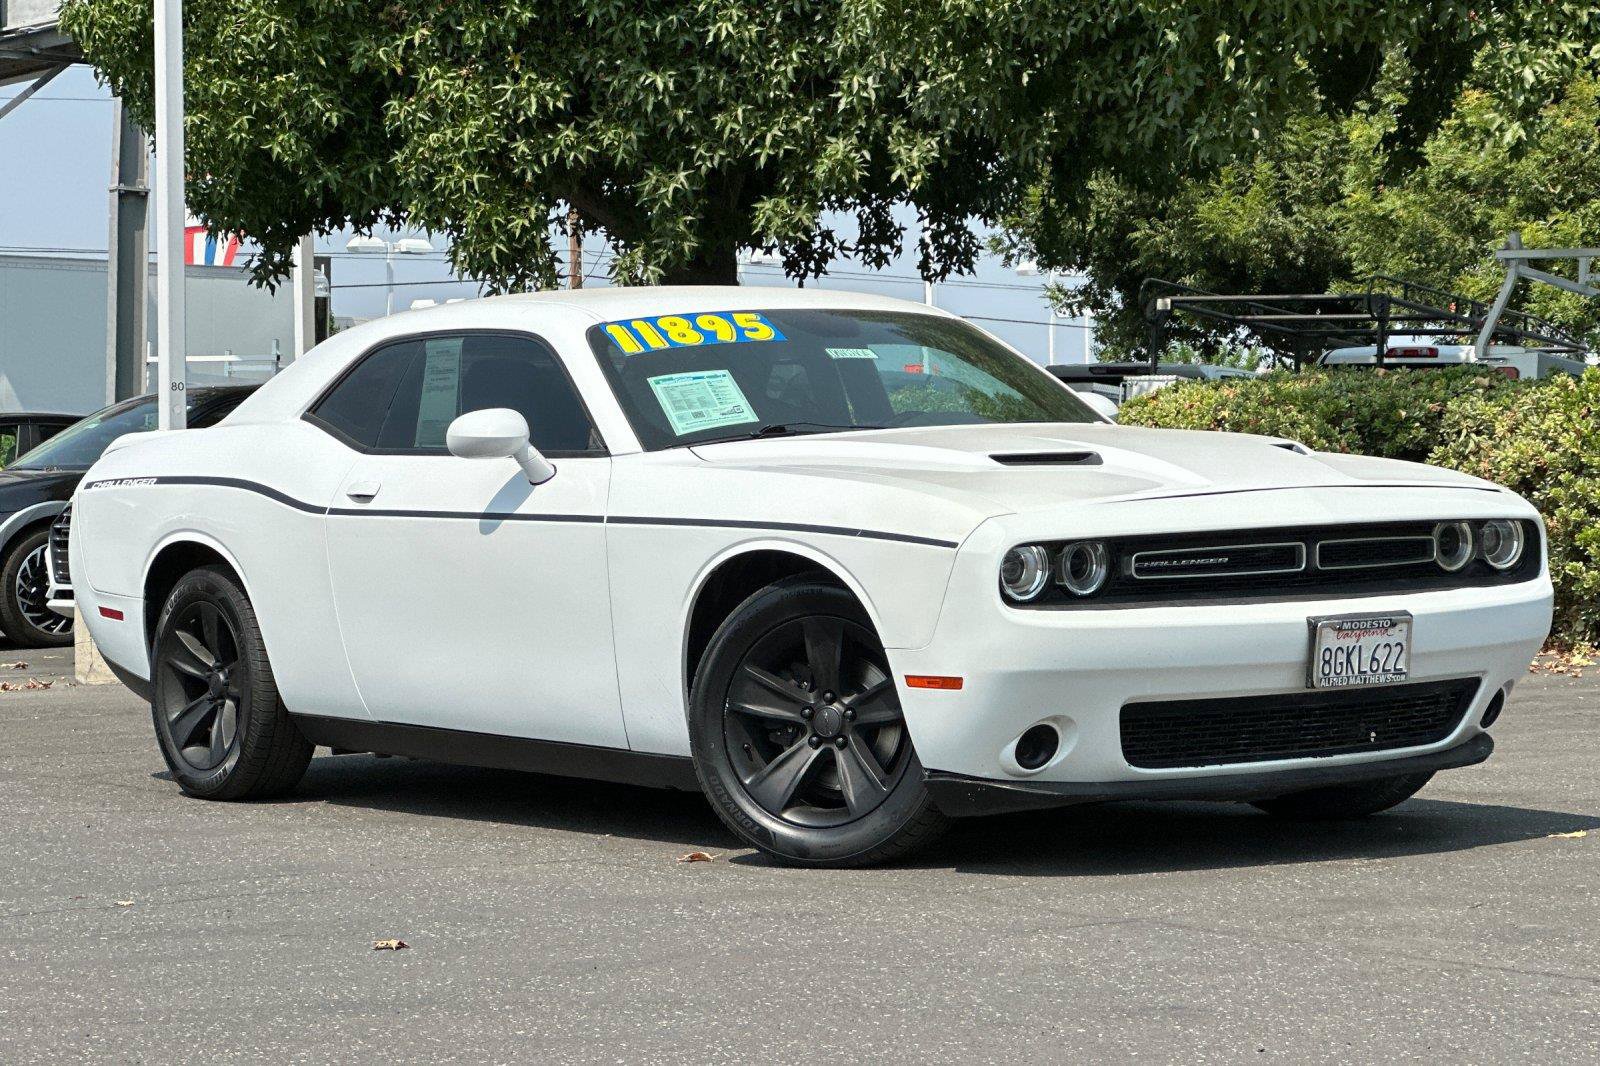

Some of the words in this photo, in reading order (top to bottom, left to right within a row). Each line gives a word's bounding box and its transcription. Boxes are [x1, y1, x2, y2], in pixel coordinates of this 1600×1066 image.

[606, 313, 774, 353] 11895
[171, 381, 185, 391] 80
[92, 477, 158, 489] CHALLENGER
[1135, 557, 1229, 567] CHALLENGER
[1342, 619, 1391, 630] MODESTO
[1321, 642, 1404, 677] 8GKL622
[1320, 676, 1347, 688] ALFRED
